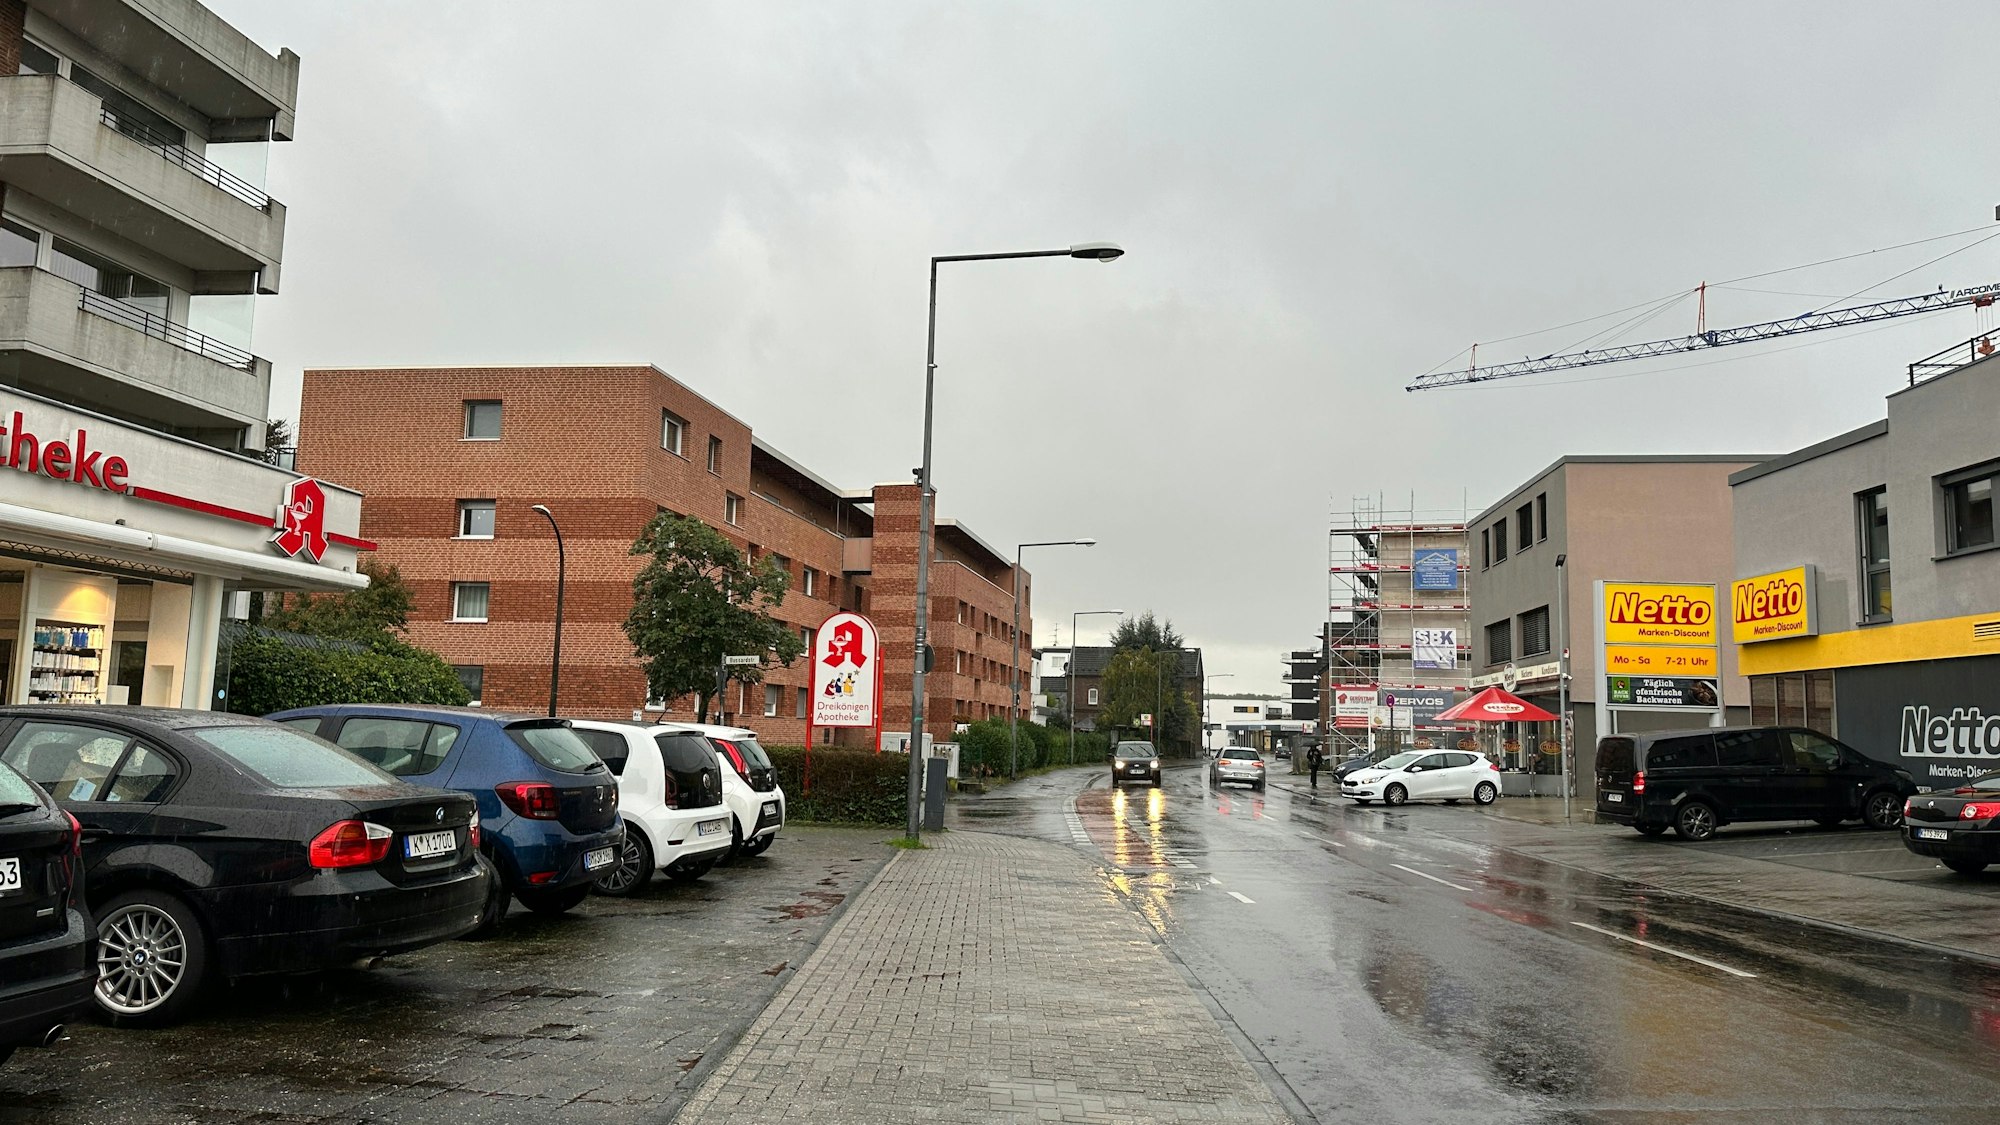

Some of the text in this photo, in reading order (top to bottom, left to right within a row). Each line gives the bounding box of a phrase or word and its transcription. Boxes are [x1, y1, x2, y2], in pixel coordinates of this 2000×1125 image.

[1736, 579, 1803, 623] Netto
[1610, 592, 1711, 625] Netto
[1638, 628, 1710, 637] Marken-Discount
[1753, 620, 1803, 635] Marken-Discount
[1415, 631, 1454, 645] SBK
[1613, 656, 1630, 664] Mo
[1638, 656, 1651, 665] Sa
[1691, 657, 1709, 666] Uhr
[1643, 679, 1674, 687] Täglich
[1636, 687, 1682, 696] ofenfrische
[1636, 695, 1682, 704] Backwaren
[817, 701, 869, 713] Dreikönigen
[816, 712, 859, 722] Apotheke
[1900, 706, 2000, 758] Netto
[413, 836, 421, 854] K
